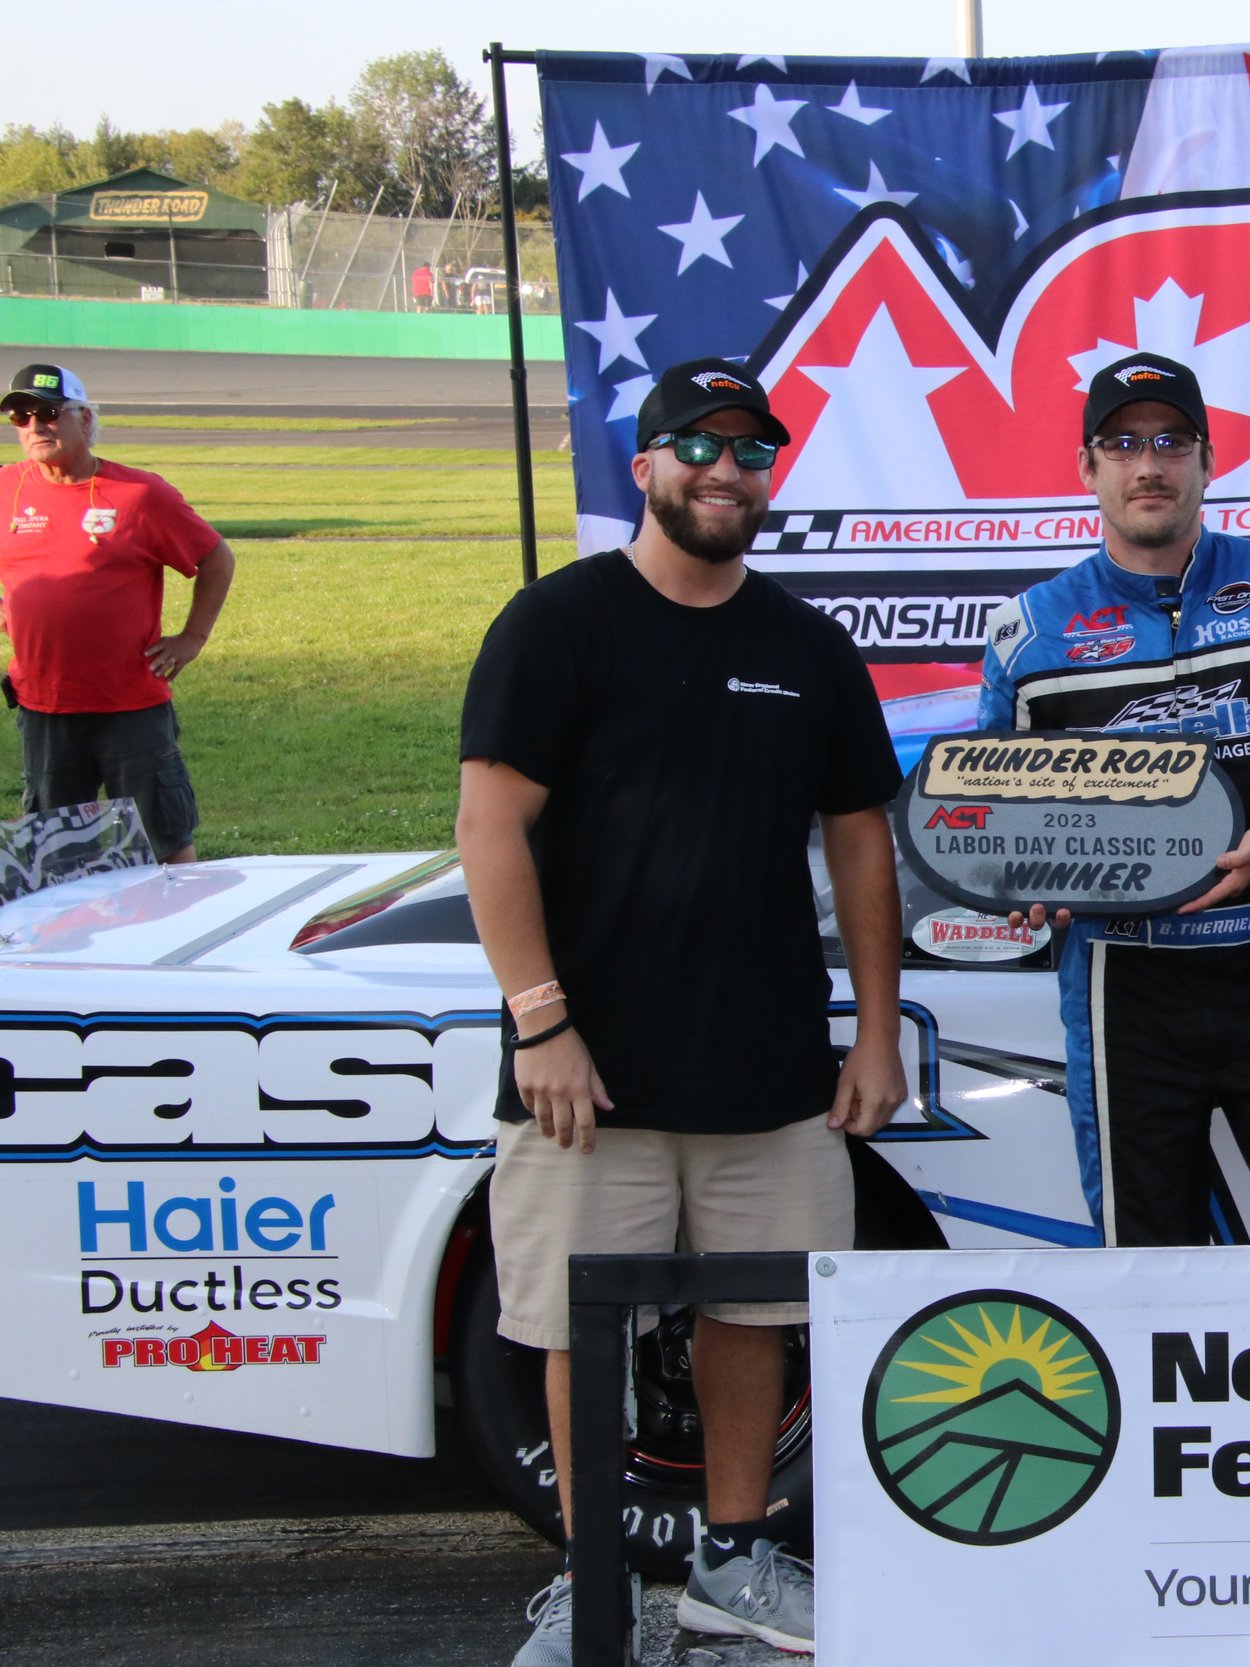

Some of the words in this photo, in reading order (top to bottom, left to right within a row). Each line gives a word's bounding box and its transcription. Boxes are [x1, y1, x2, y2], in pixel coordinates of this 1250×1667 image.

[98, 198, 160, 214] THUNDER
[162, 198, 201, 214] ROAD
[33, 374, 59, 389] 86
[711, 380, 740, 390] nefcu
[1130, 372, 1161, 381] nefcu
[82, 508, 117, 534] 5
[1206, 595, 1235, 603] FAST
[1062, 605, 1129, 634] ACT
[993, 619, 1021, 646] K1
[941, 745, 1098, 774] THUNDER
[1100, 746, 1197, 775] ROAD
[1029, 776, 1055, 788] site
[1062, 776, 1077, 793] of
[923, 804, 994, 830] ACT
[1043, 813, 1097, 828] 2023
[935, 835, 1005, 855] LABOR
[1015, 835, 1055, 855] DAY
[1066, 836, 1156, 857] CLASSIC
[1165, 838, 1204, 857] 200
[1004, 860, 1153, 892] WINNER
[930, 918, 1036, 947] WADDELL
[1159, 922, 1176, 936] B.
[77, 1176, 336, 1253] Haier
[81, 1265, 343, 1315] Ductless
[166, 1325, 180, 1334] by
[102, 1336, 200, 1368] PRO
[211, 1335, 327, 1365] HEAT
